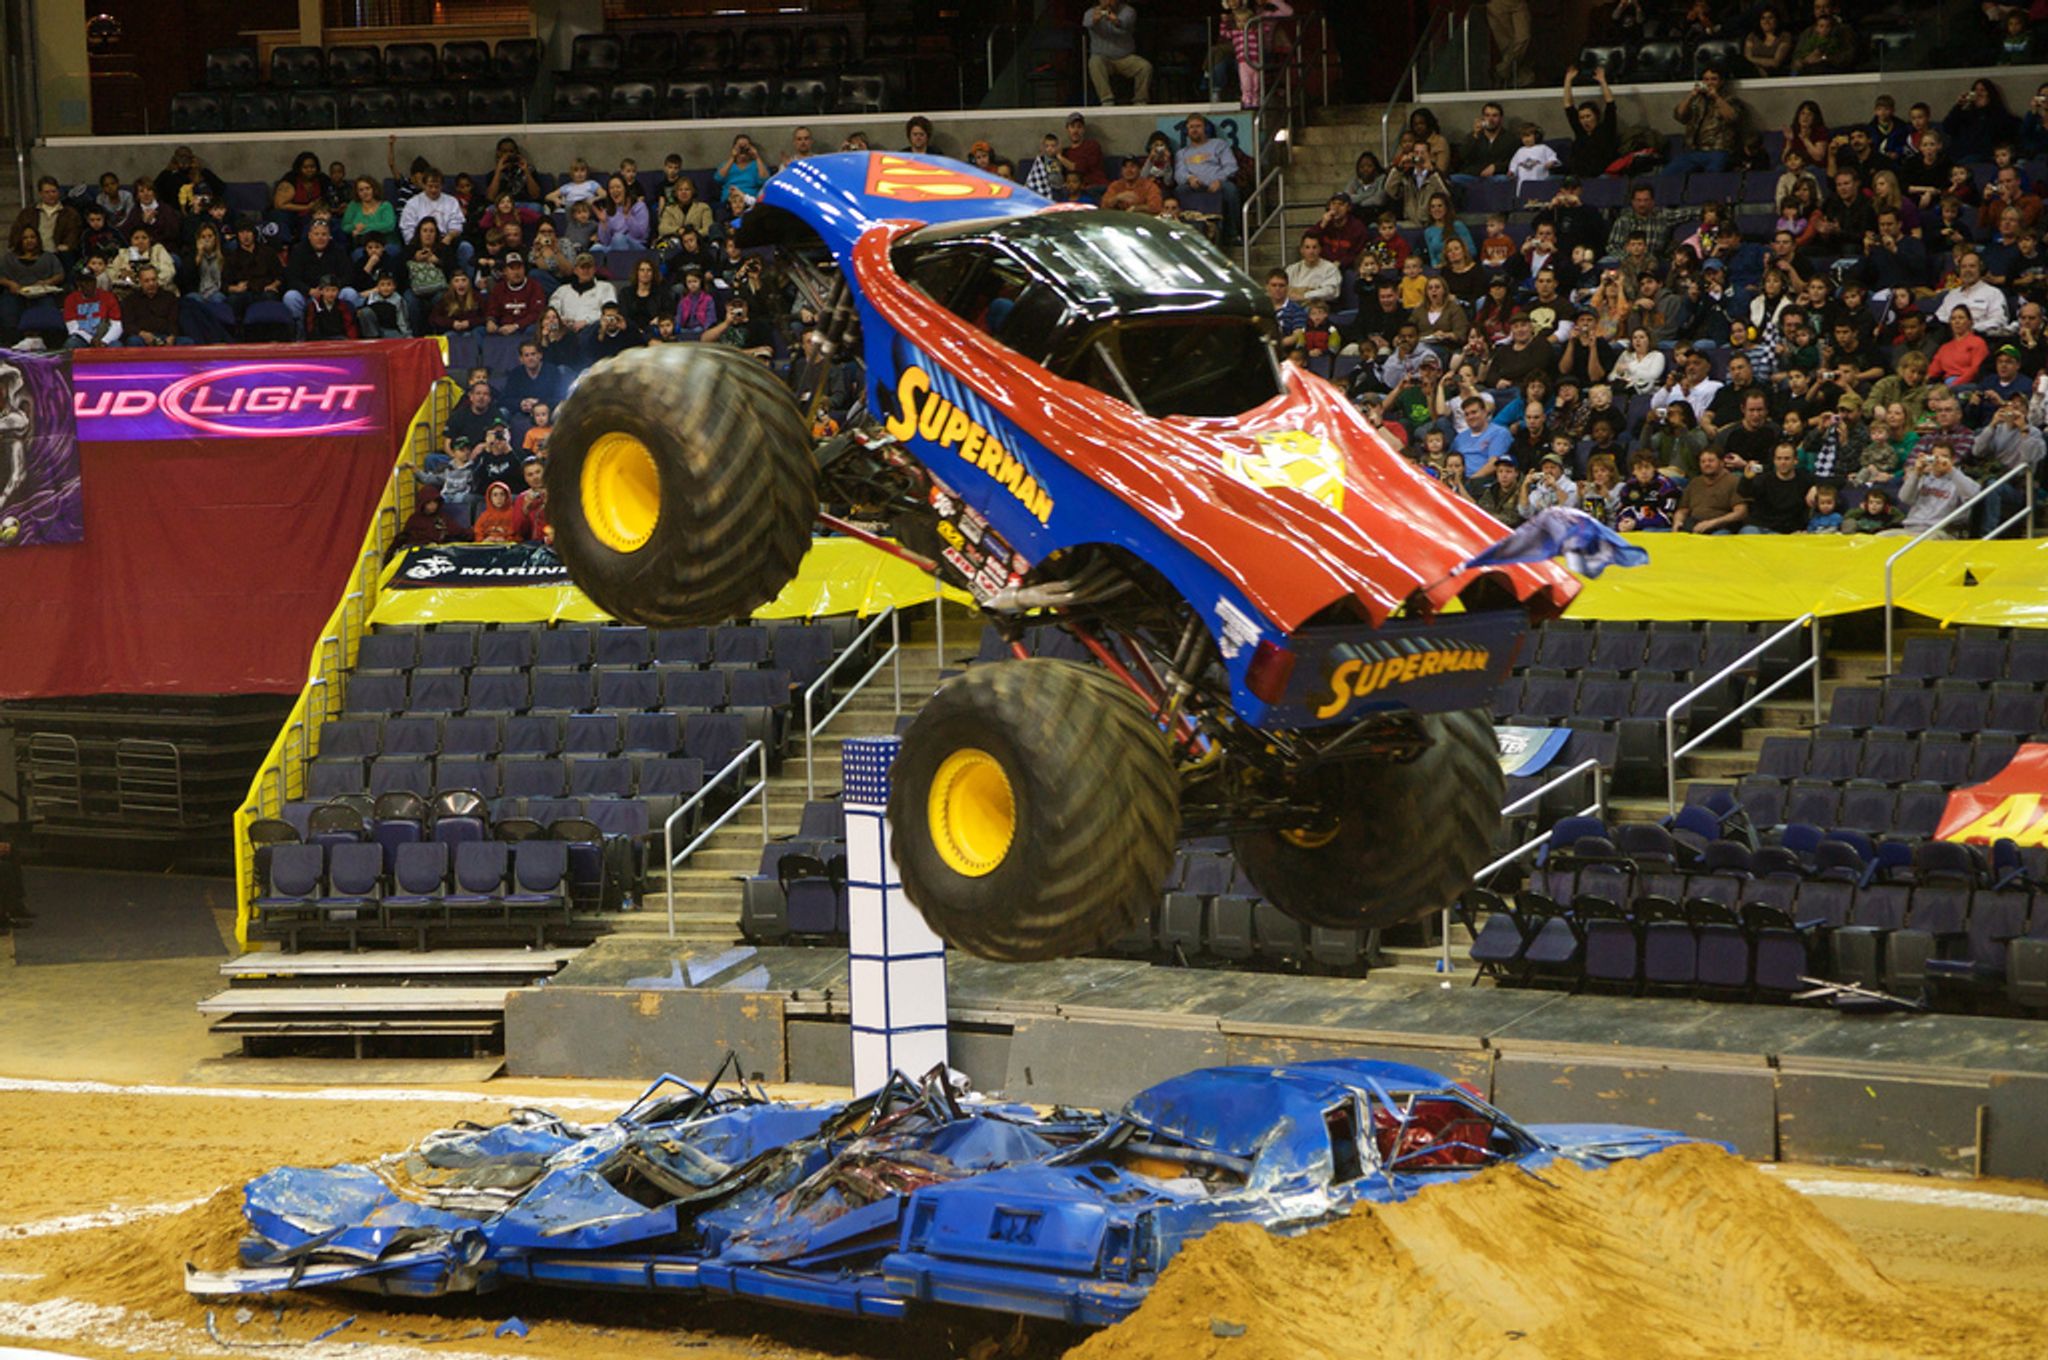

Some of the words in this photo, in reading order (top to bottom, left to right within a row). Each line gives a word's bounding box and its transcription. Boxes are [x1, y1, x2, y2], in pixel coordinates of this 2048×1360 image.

[74, 390, 157, 417] UD
[189, 384, 376, 414] LIGHT
[886, 365, 1055, 524] SUPERMAN
[1316, 649, 1490, 720] SUPERMAN
